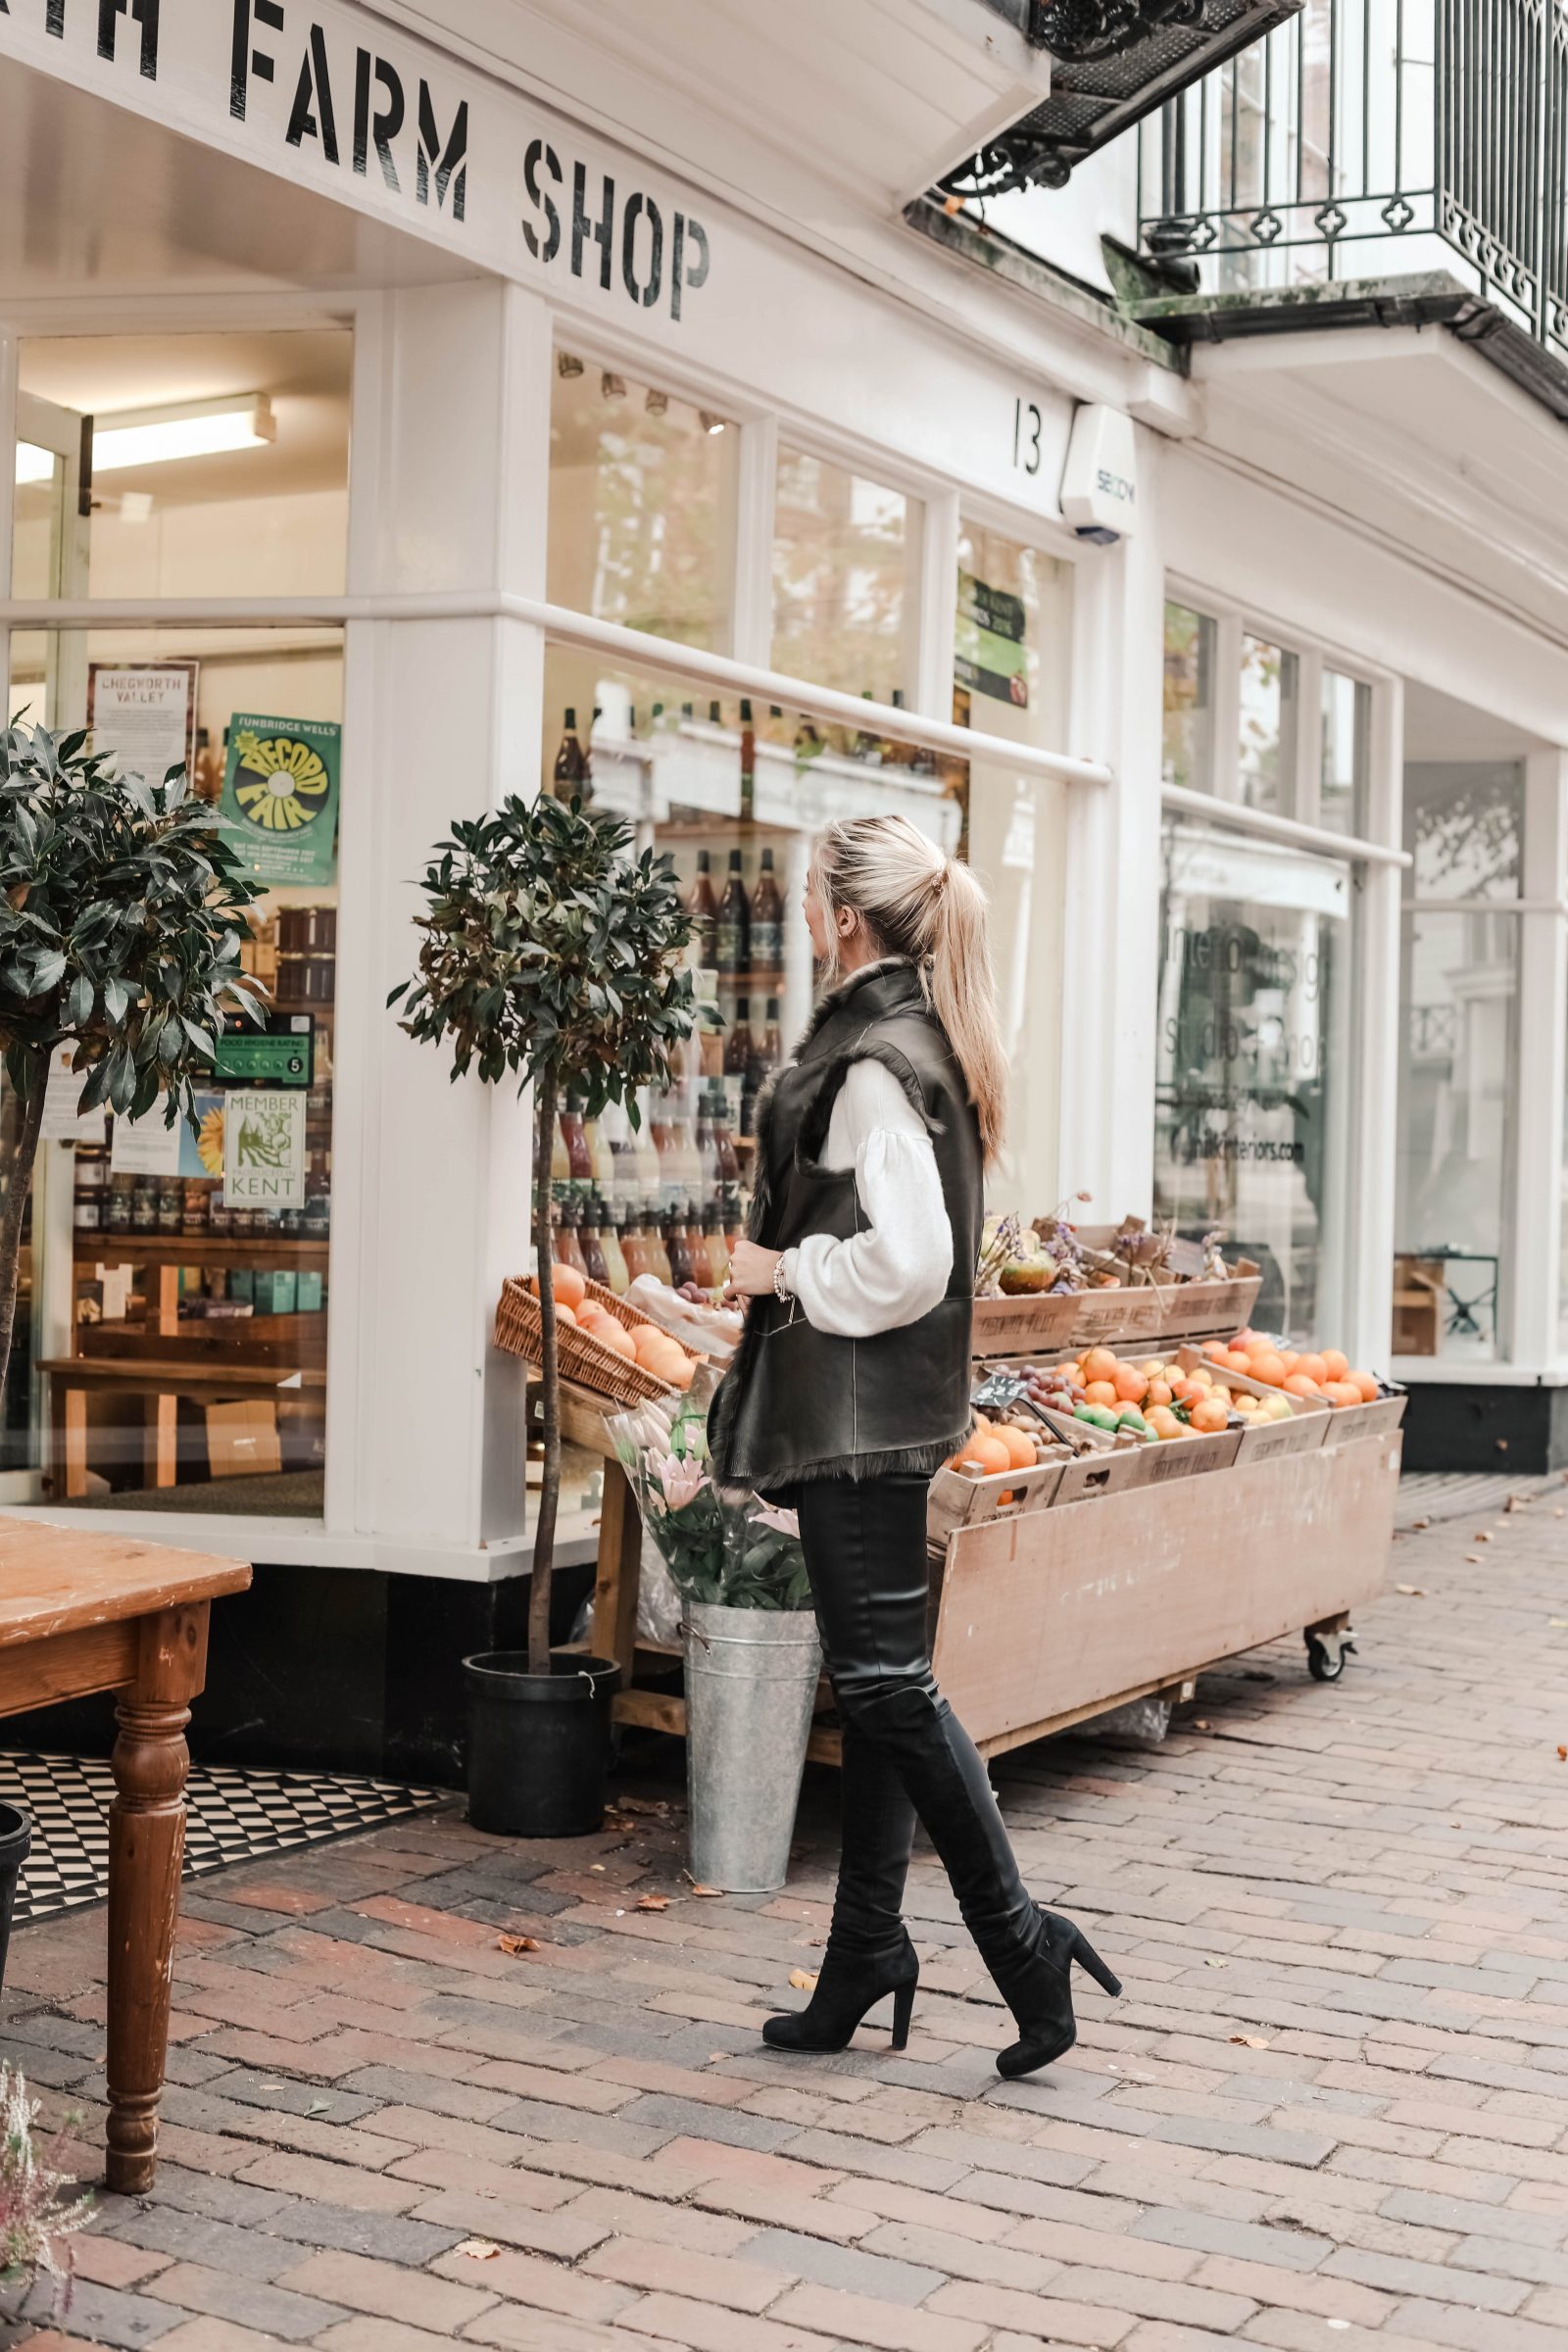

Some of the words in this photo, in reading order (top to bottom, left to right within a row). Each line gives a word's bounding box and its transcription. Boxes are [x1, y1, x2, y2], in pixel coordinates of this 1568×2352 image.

[229, 0, 468, 222] FARM
[521, 138, 710, 321] SHOP
[1013, 397, 1042, 475] 13
[102, 677, 181, 690] CHEGWORTH
[117, 691, 165, 704] VALLEY
[238, 716, 300, 732] TUNBRIDGE
[302, 723, 336, 736] WELLS
[239, 738, 328, 796] RECORD
[235, 783, 318, 831] FAIR
[220, 1039, 242, 1048] FOOD
[244, 1039, 275, 1048] HYGIENE
[277, 1039, 304, 1049] RATING
[291, 1058, 301, 1073] 5
[230, 1096, 298, 1111] MEMBER
[231, 1178, 296, 1196] KENT
